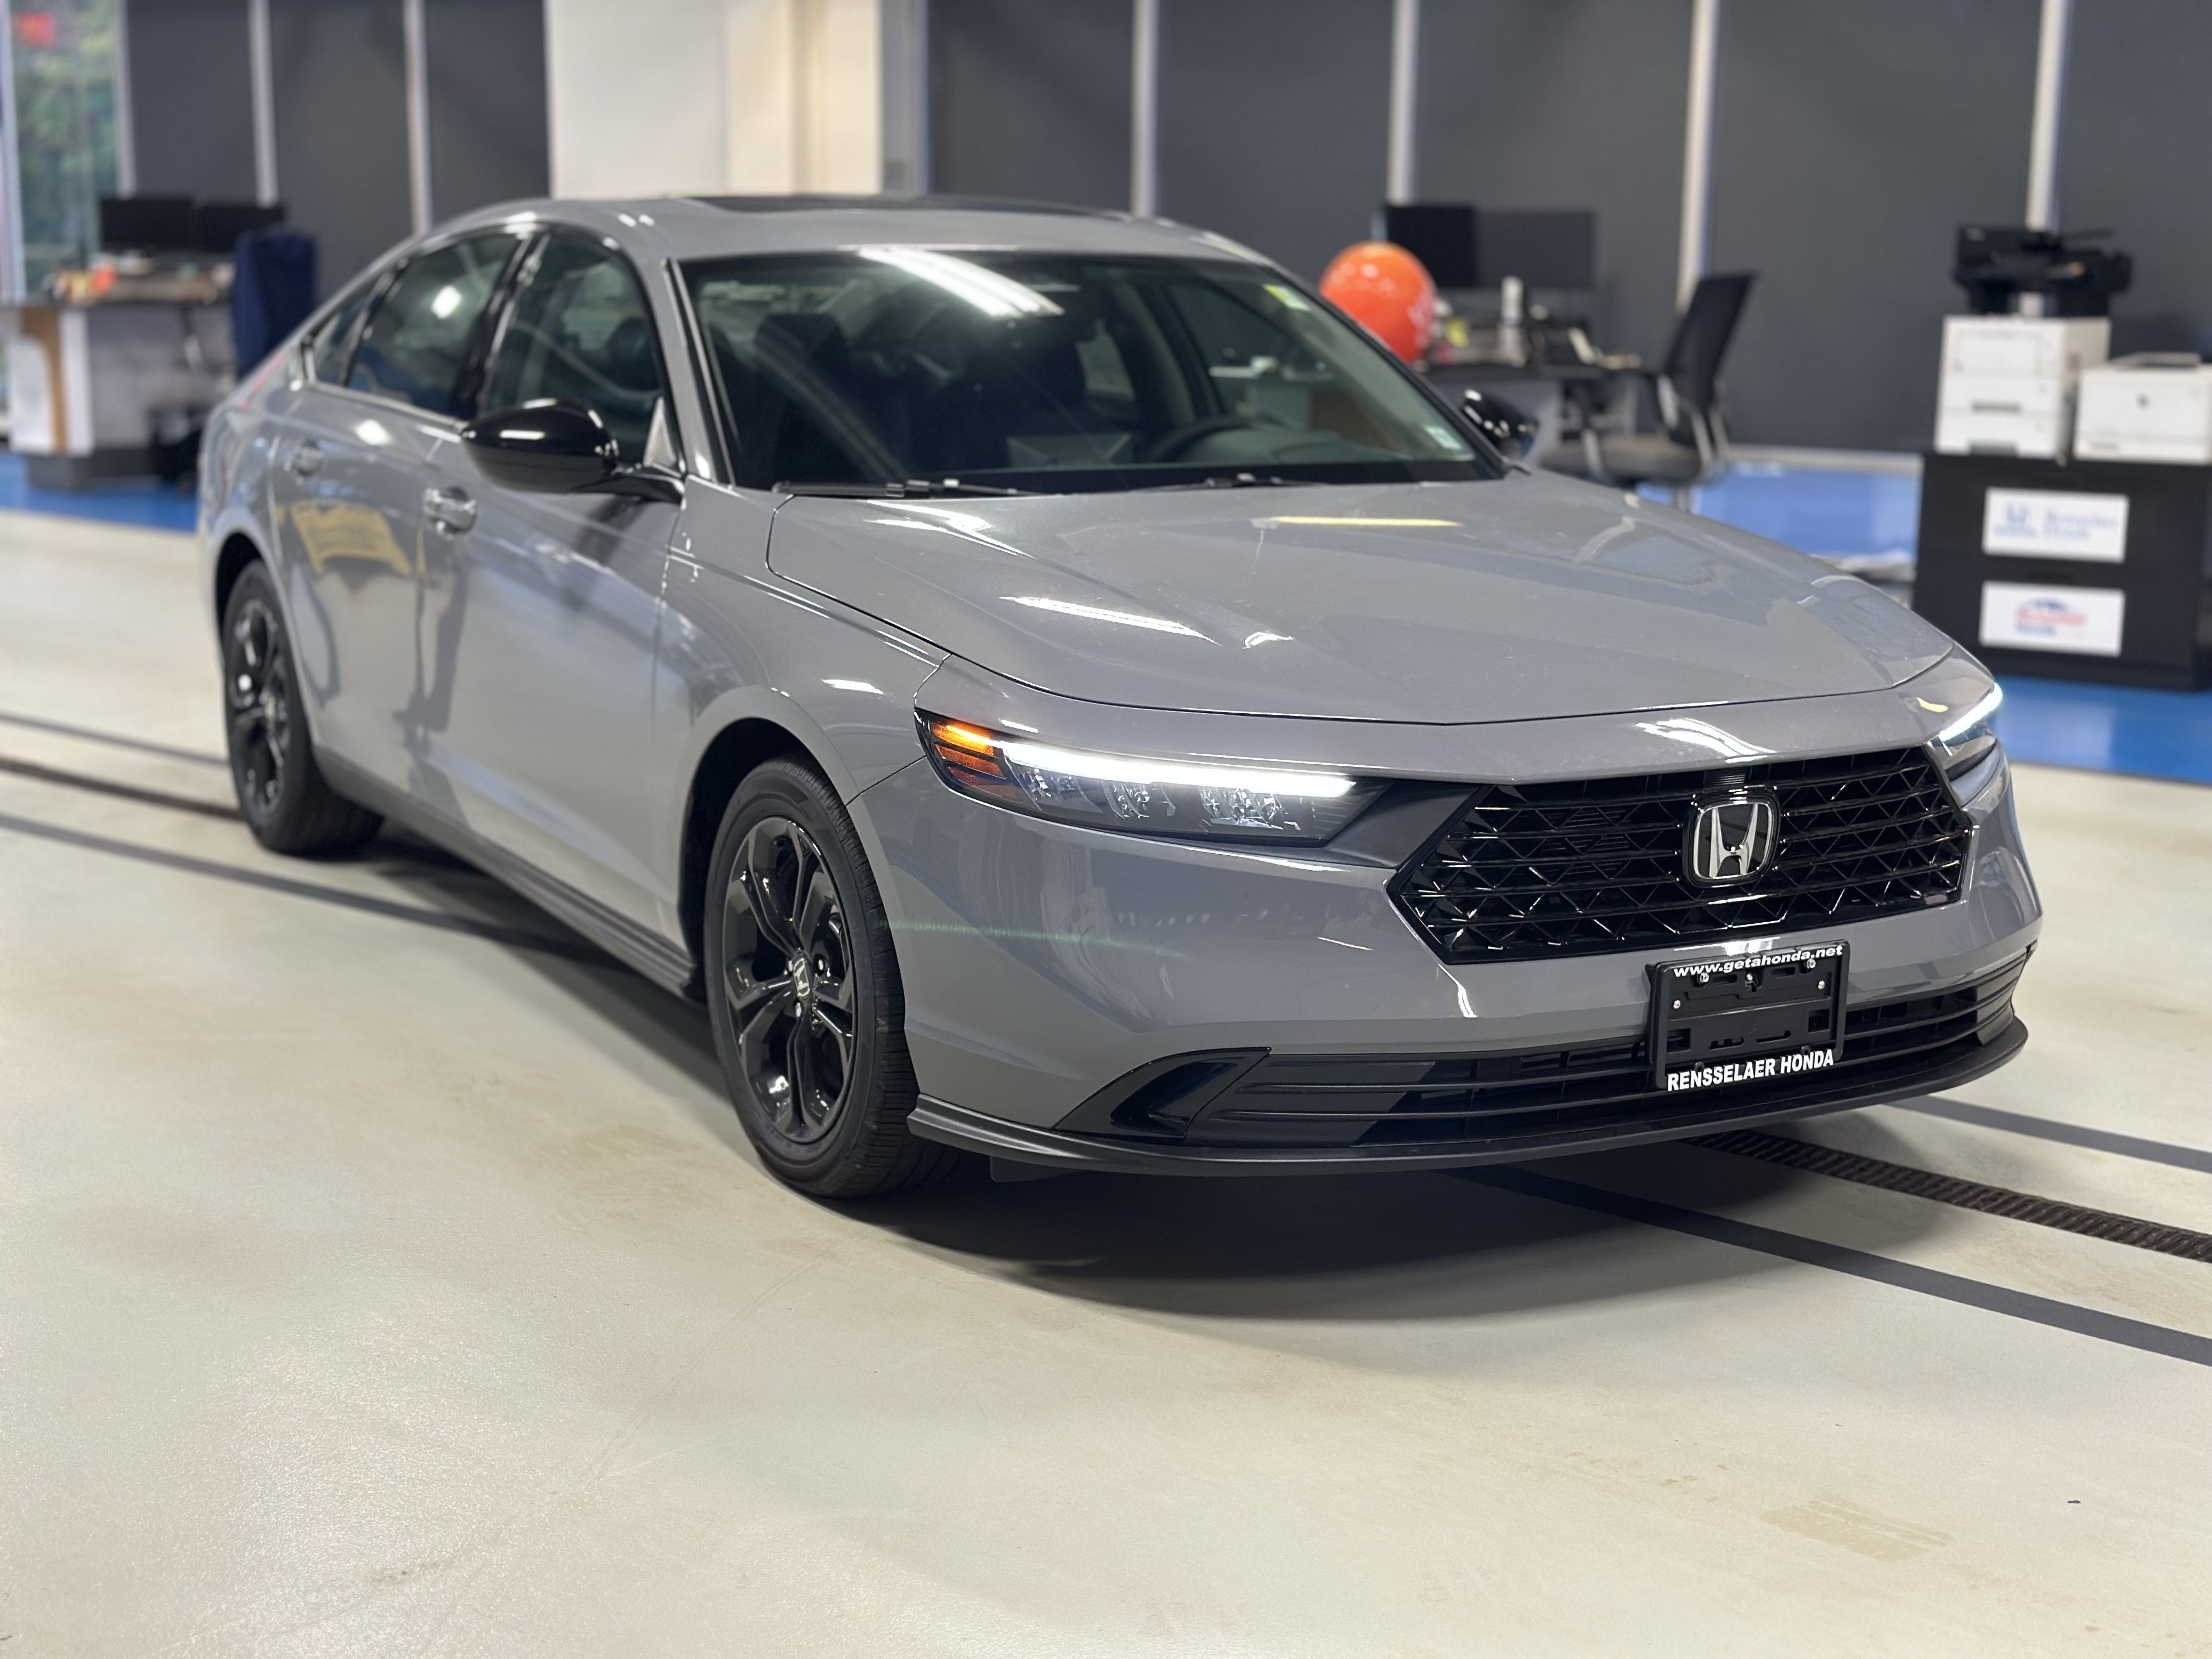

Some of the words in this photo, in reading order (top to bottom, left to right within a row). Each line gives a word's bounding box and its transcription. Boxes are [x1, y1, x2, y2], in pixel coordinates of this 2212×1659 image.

[1673, 945, 1843, 978] www.getahonda.net
[1667, 1058, 1775, 1091] RENSSELAER
[1780, 1048, 1834, 1074] HONDA
